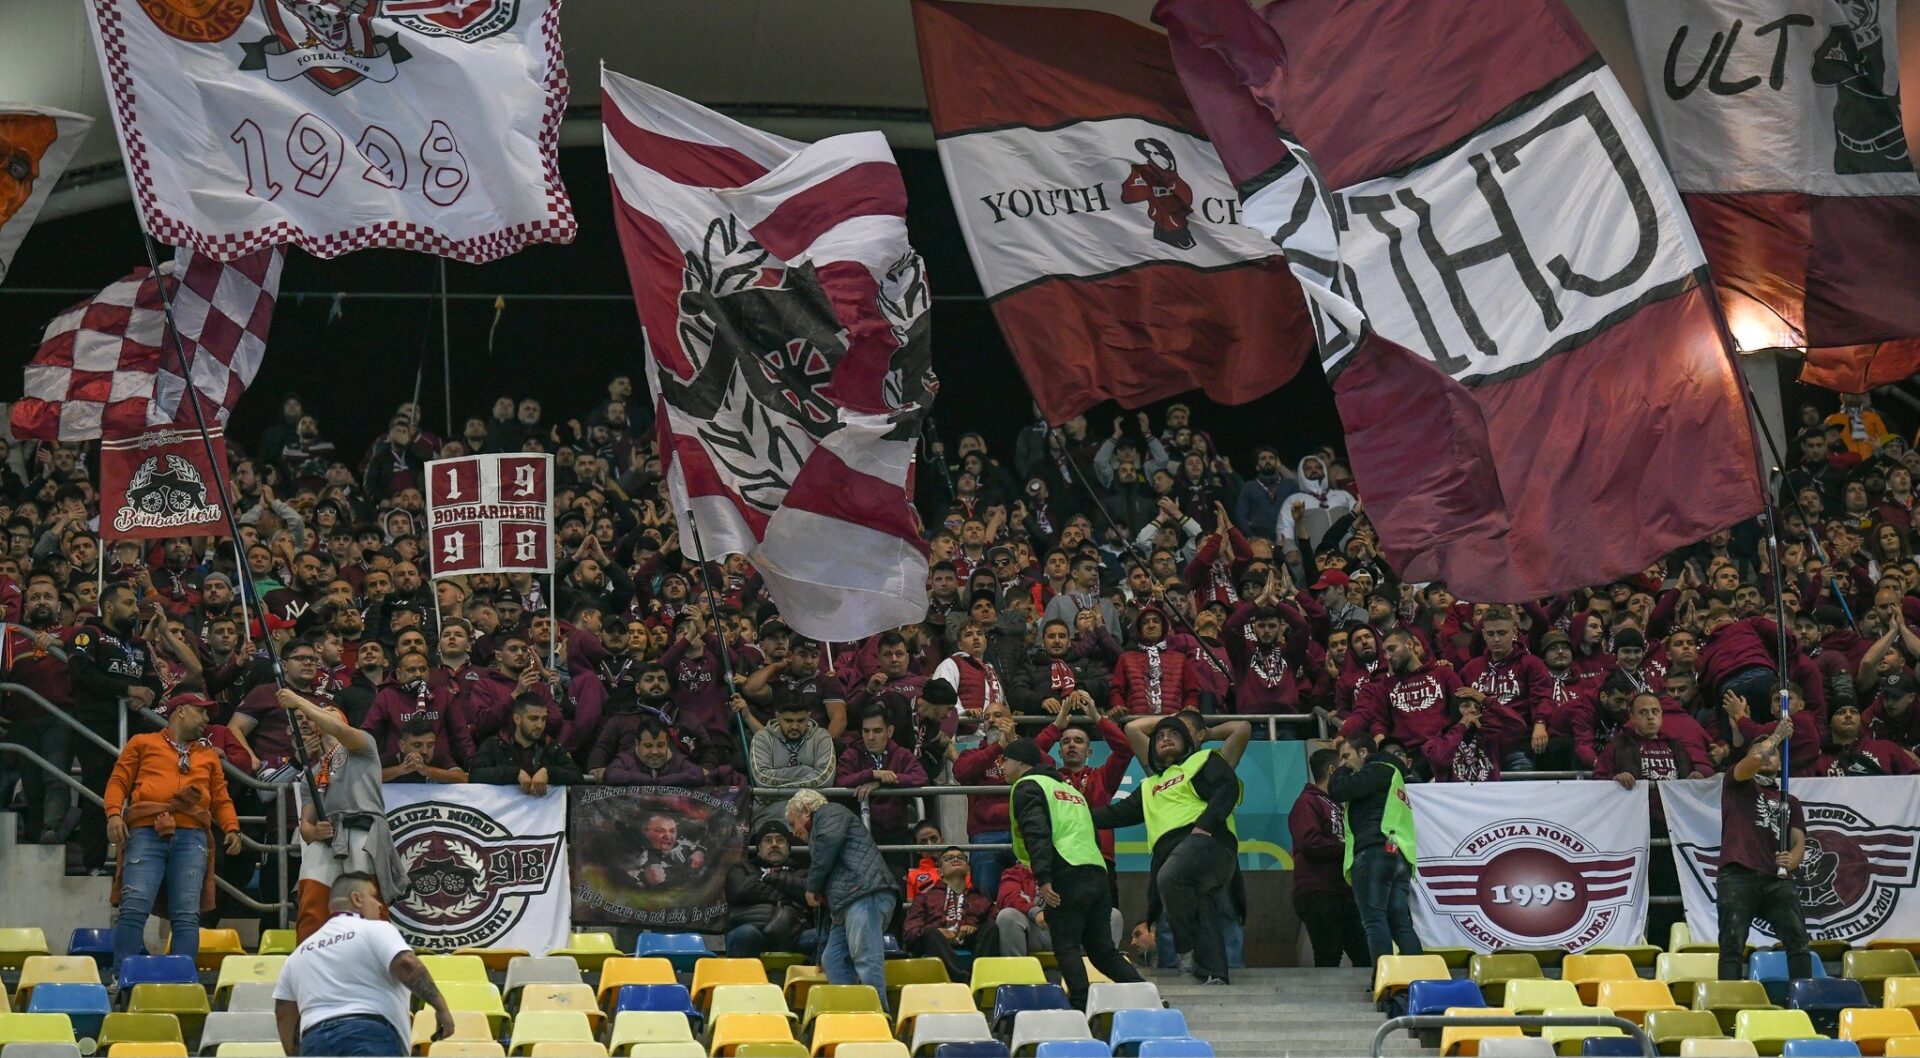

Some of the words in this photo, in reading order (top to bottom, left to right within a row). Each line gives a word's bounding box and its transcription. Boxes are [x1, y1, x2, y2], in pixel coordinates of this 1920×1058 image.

[142, 0, 246, 38] OLIGANS
[404, 19, 442, 33] RAPID
[297, 52, 339, 66] FOTBAL
[342, 56, 370, 72] CLUB
[230, 112, 470, 207] 1998
[979, 182, 1111, 225] YOUTH
[446, 468, 462, 499] 1
[513, 463, 536, 497] 9
[113, 503, 222, 532] Bombardierii
[433, 504, 546, 524] BOMBARDIERII
[443, 530, 465, 564] 9
[515, 528, 537, 562] 8
[388, 807, 443, 832] ELUZA
[447, 809, 495, 835] NORD
[1808, 808, 1858, 826] NORD
[1465, 824, 1531, 855] PELUZA
[1536, 827, 1586, 853] NORD
[488, 848, 546, 885] 98
[1490, 880, 1577, 907] 1998
[1872, 888, 1893, 918] 2010
[300, 942, 315, 955] FC
[318, 931, 356, 949] RAPID
[398, 909, 513, 949] MBARDIERII
[1566, 909, 1612, 950] RADEA
